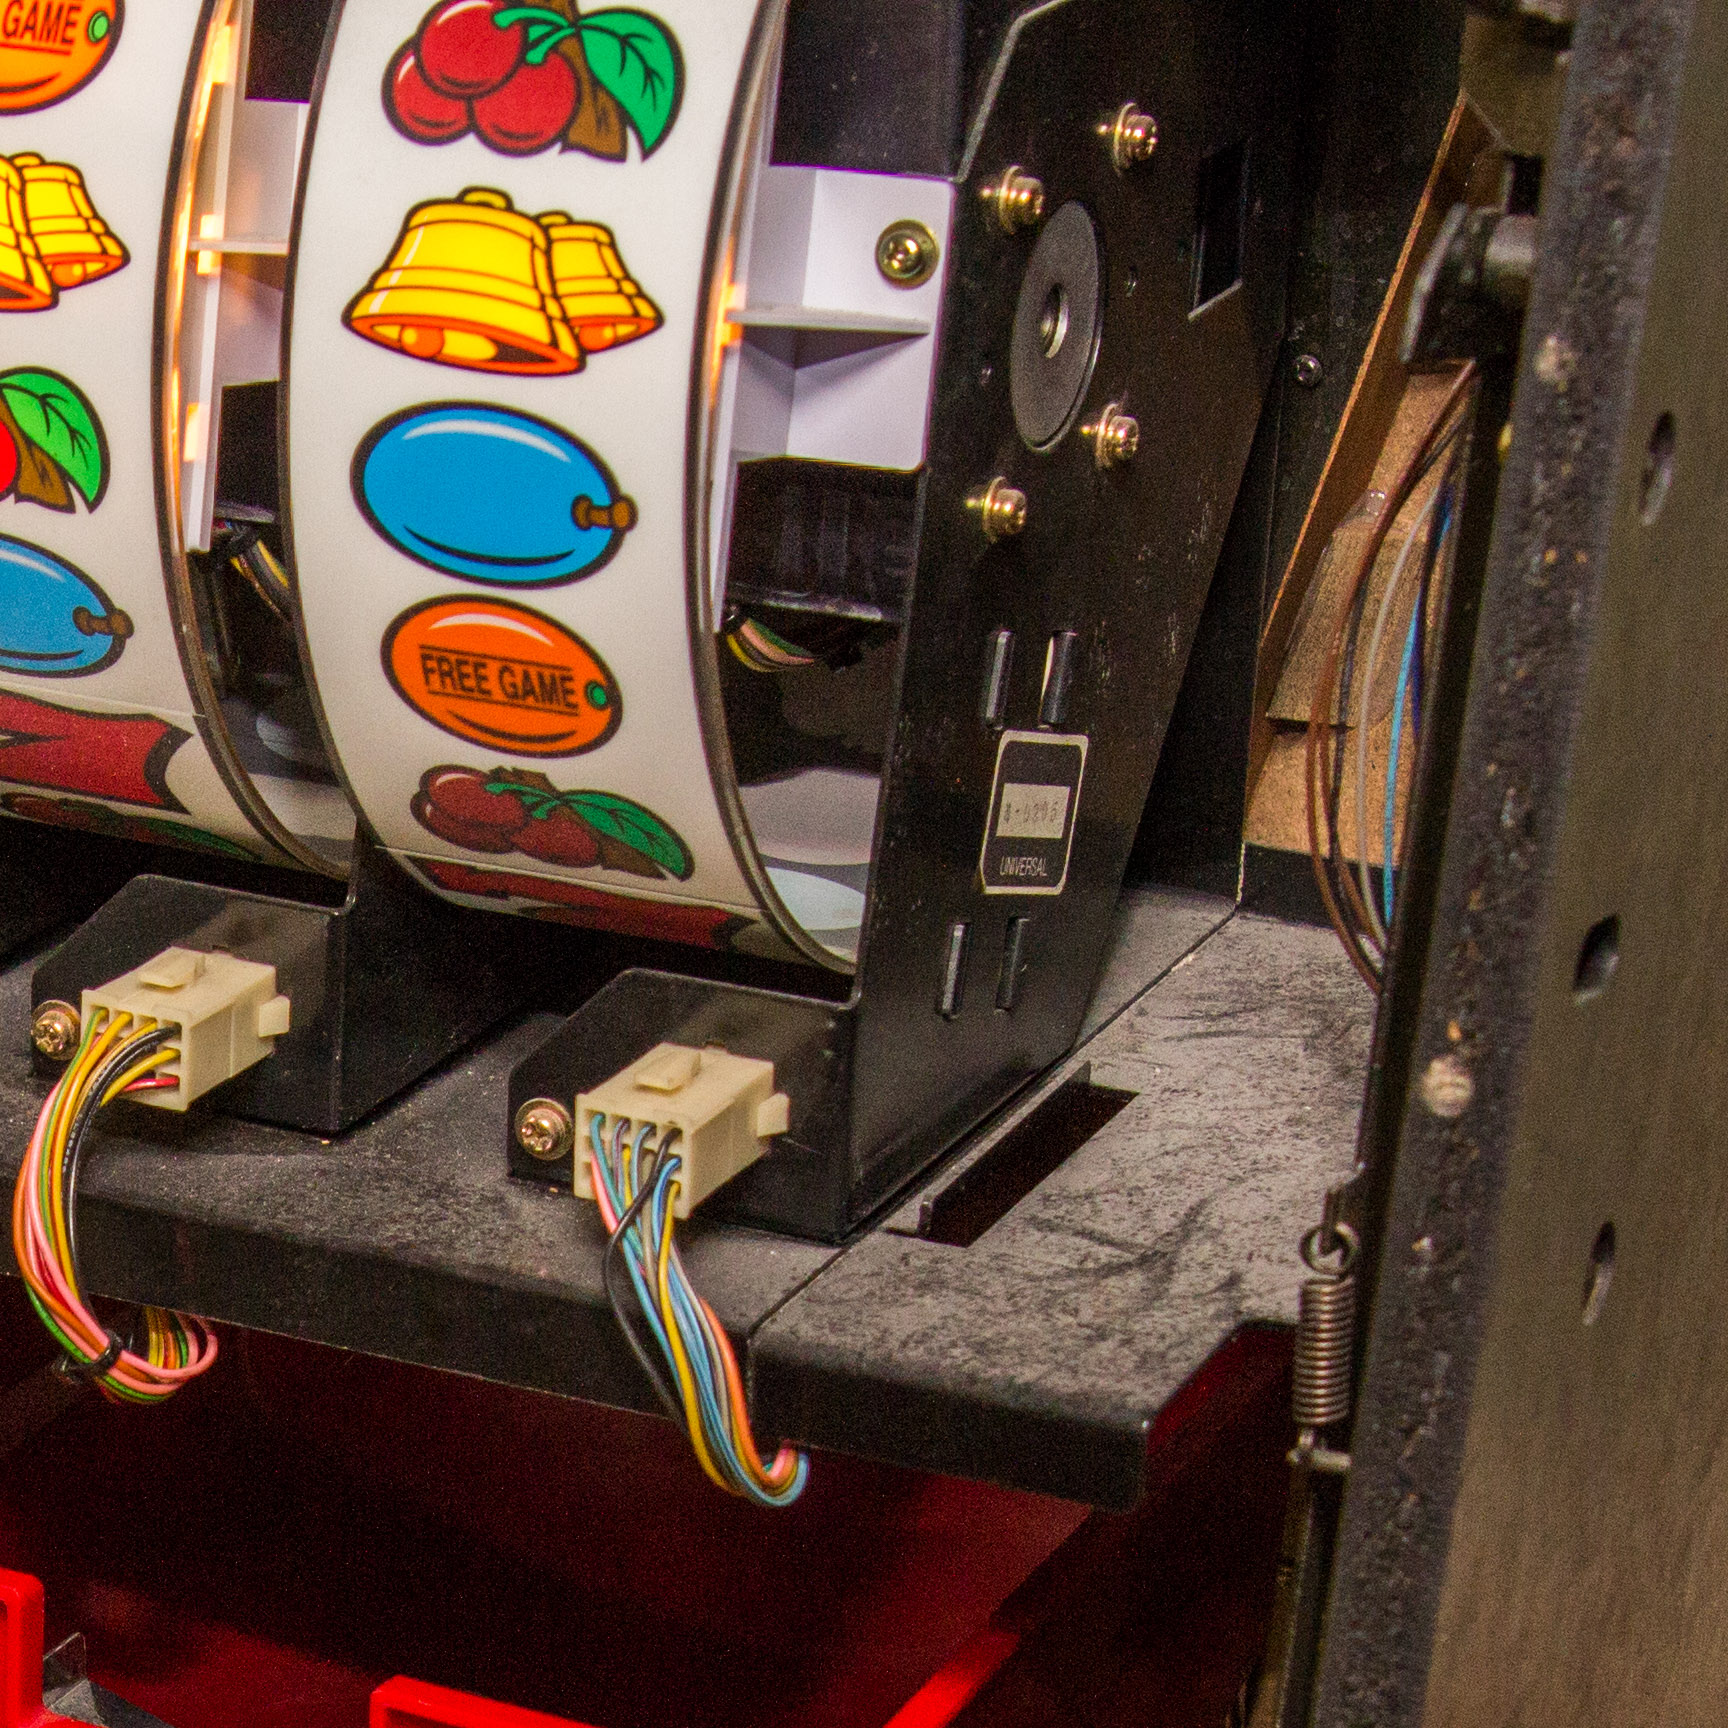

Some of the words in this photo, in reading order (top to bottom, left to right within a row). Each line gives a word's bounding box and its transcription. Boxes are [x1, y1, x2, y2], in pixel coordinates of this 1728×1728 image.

[2, 0, 82, 45] GAME
[420, 653, 492, 697] FREE
[498, 665, 580, 710] GAME
[999, 855, 1048, 877] UNIVERSAL
